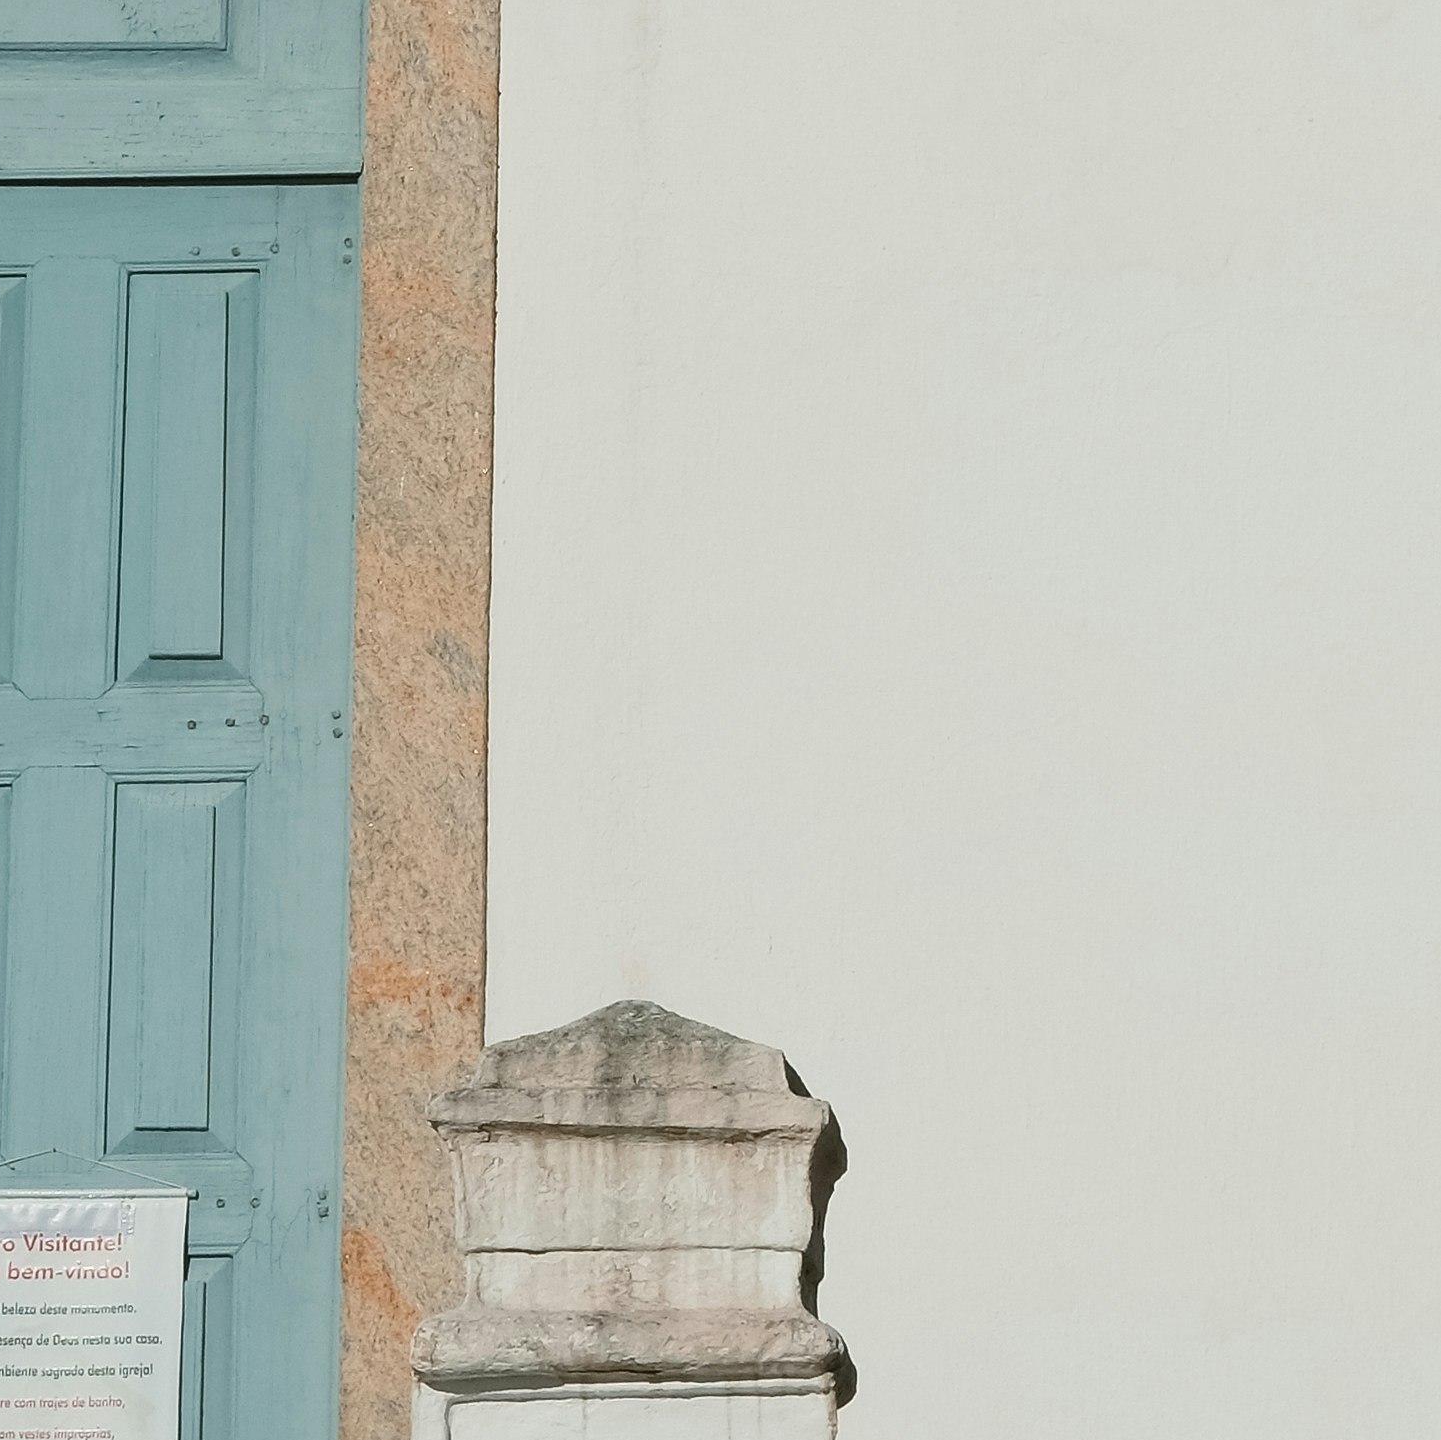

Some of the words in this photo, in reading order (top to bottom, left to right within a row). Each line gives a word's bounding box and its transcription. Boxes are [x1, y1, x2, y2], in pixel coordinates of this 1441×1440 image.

[23, 1233, 122, 1252] Visitante!
[8, 1261, 129, 1279] bem-vindo!
[2, 1302, 36, 1315] beleza
[40, 1302, 67, 1315] deste
[71, 1304, 136, 1314] monumento.
[36, 1333, 49, 1346] de
[53, 1334, 79, 1345] Deus
[83, 1336, 110, 1345] nesta
[114, 1336, 131, 1344] sua
[136, 1335, 162, 1345] casa.
[41, 1364, 84, 1379] sagrado
[88, 1364, 115, 1376] desta
[119, 1363, 153, 1378] igreja!
[14, 1400, 35, 1408] com
[40, 1396, 68, 1411] trajes
[72, 1396, 85, 1407] de
[89, 1395, 125, 1409] banho,
[19, 1430, 50, 1439] vestes
